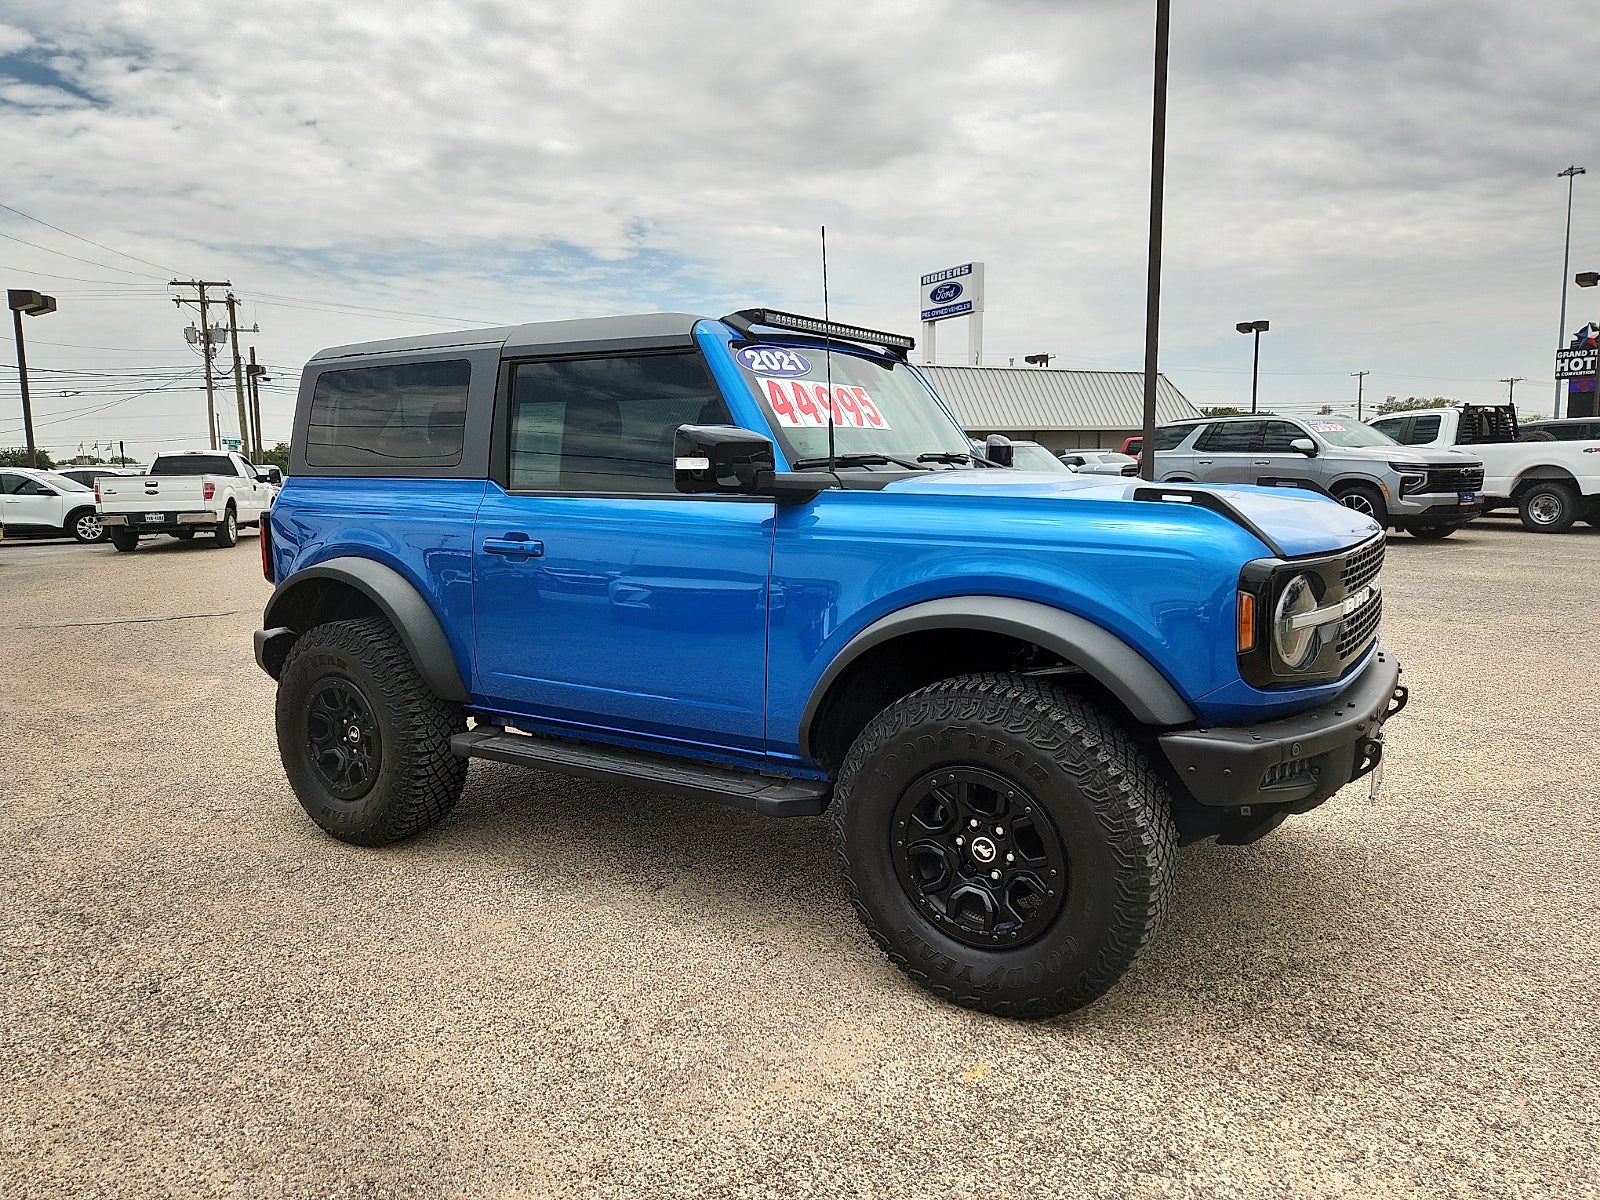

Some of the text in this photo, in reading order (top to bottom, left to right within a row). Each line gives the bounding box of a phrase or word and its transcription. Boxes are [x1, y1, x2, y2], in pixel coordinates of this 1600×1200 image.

[922, 265, 970, 285] ROGERS
[935, 284, 956, 301] Ford
[948, 302, 971, 314] VEHICLES
[744, 349, 807, 371] 2021
[1557, 350, 1588, 359] GRAND
[1556, 356, 1598, 372] HOT
[1561, 369, 1596, 377] CONVENTION
[766, 379, 883, 427] 44995
